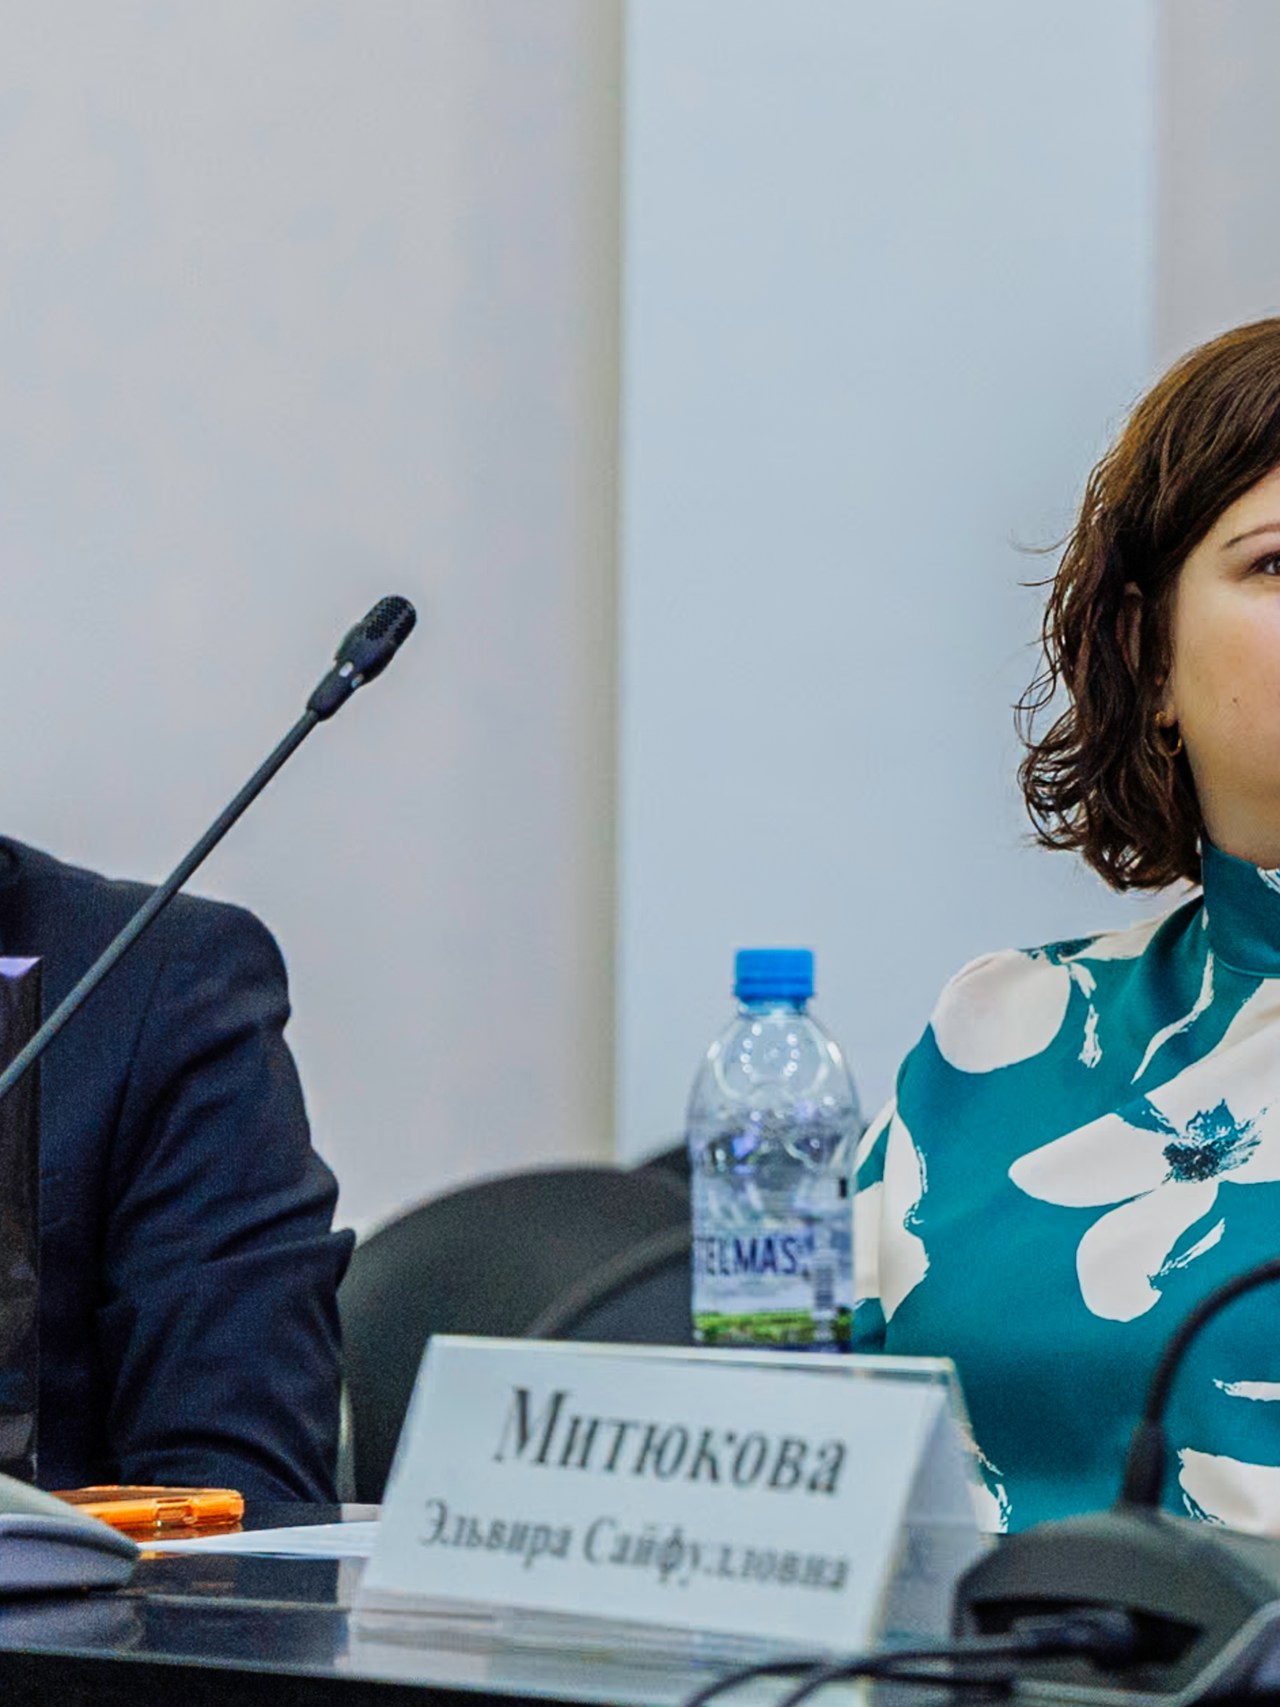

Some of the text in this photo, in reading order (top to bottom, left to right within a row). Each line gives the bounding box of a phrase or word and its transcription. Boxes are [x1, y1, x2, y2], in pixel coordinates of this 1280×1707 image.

[494, 1385, 849, 1496] Митюкова
[418, 1498, 850, 1592] Эльвира Сайфулловна
